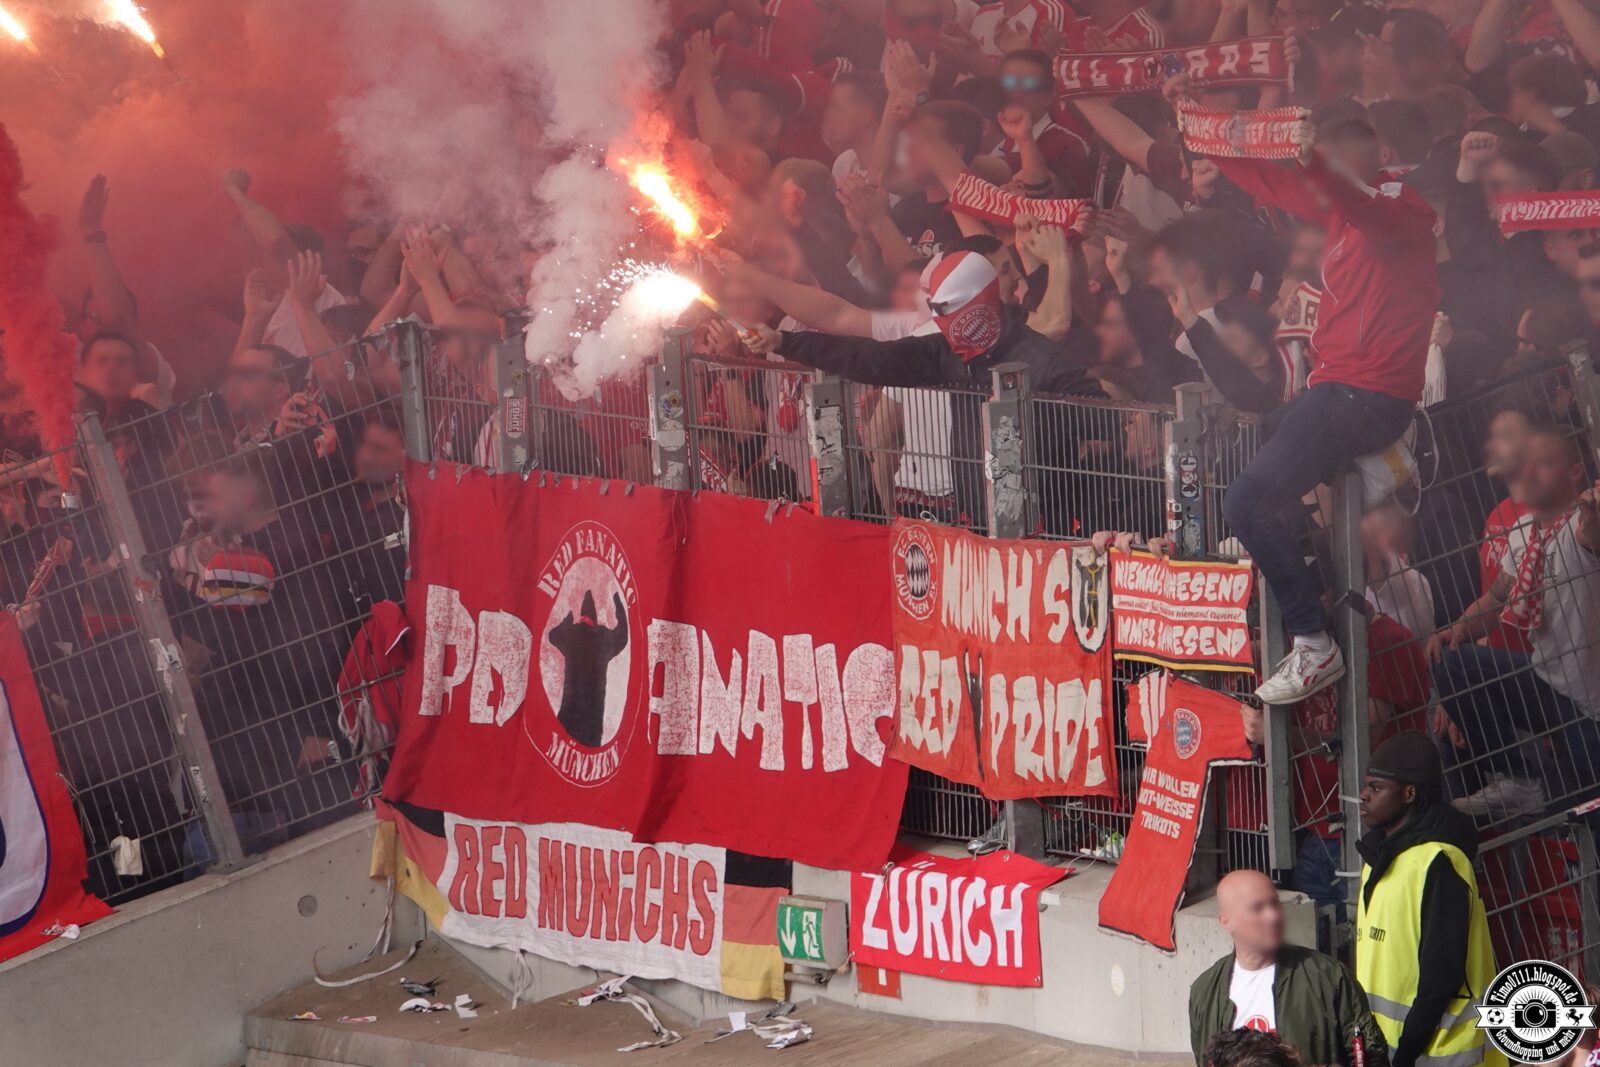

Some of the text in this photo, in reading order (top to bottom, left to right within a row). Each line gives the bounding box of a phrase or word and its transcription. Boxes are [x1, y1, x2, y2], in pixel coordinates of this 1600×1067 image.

[537, 529, 636, 609] RED FANATIC
[546, 731, 619, 782] MÜNCHEN
[899, 645, 1107, 787] RED PRIDE
[1140, 810, 1181, 839] TRIKOTS
[449, 823, 528, 919] RED
[861, 860, 1032, 968] ZÜRICH
